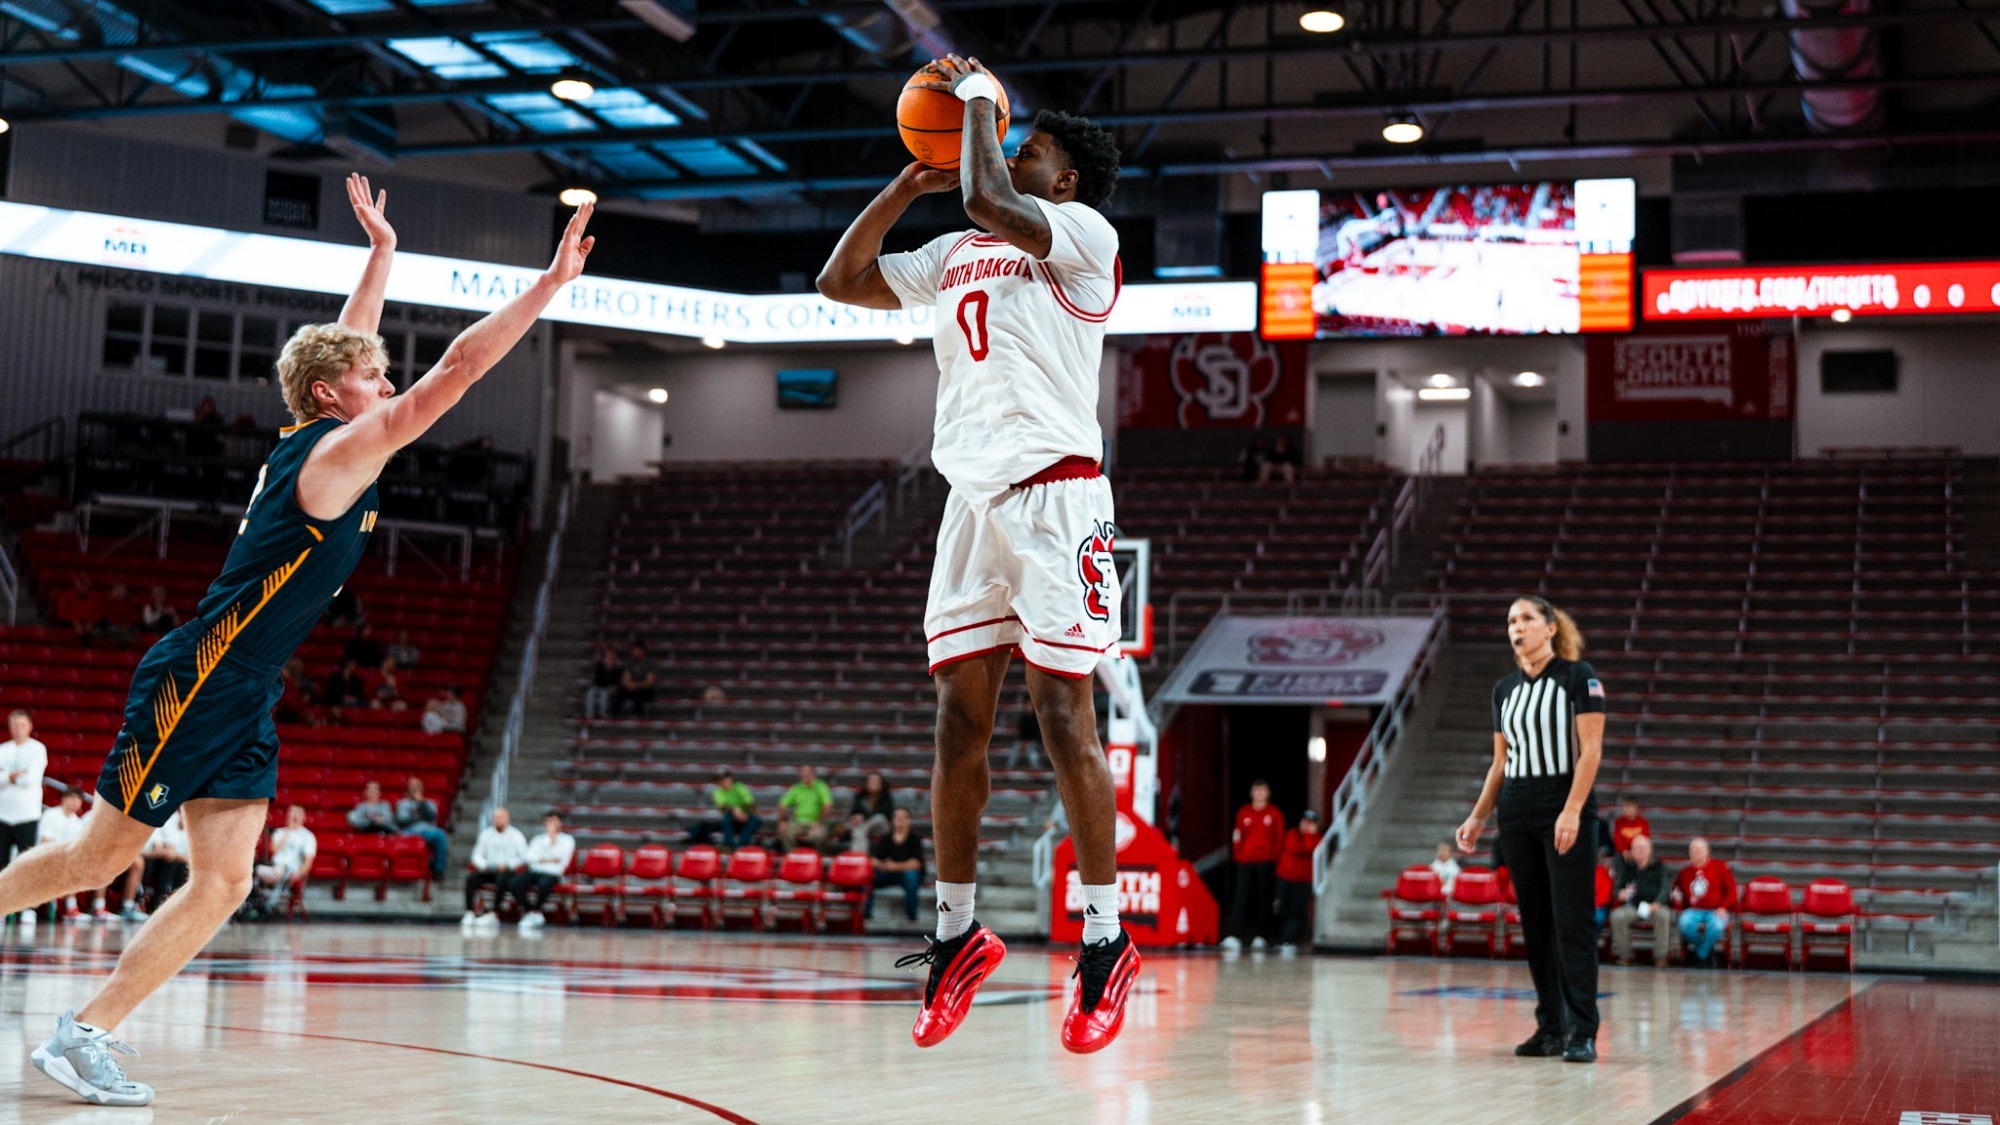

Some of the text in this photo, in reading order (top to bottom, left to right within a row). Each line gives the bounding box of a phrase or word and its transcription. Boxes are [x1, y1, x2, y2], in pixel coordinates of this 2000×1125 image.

[570, 284, 750, 329] BROTHERS
[957, 290, 989, 362] 0
[1627, 343, 1731, 367] SOUTH
[1627, 366, 1731, 386] DAKOTA
[1064, 631, 1085, 639] adidas
